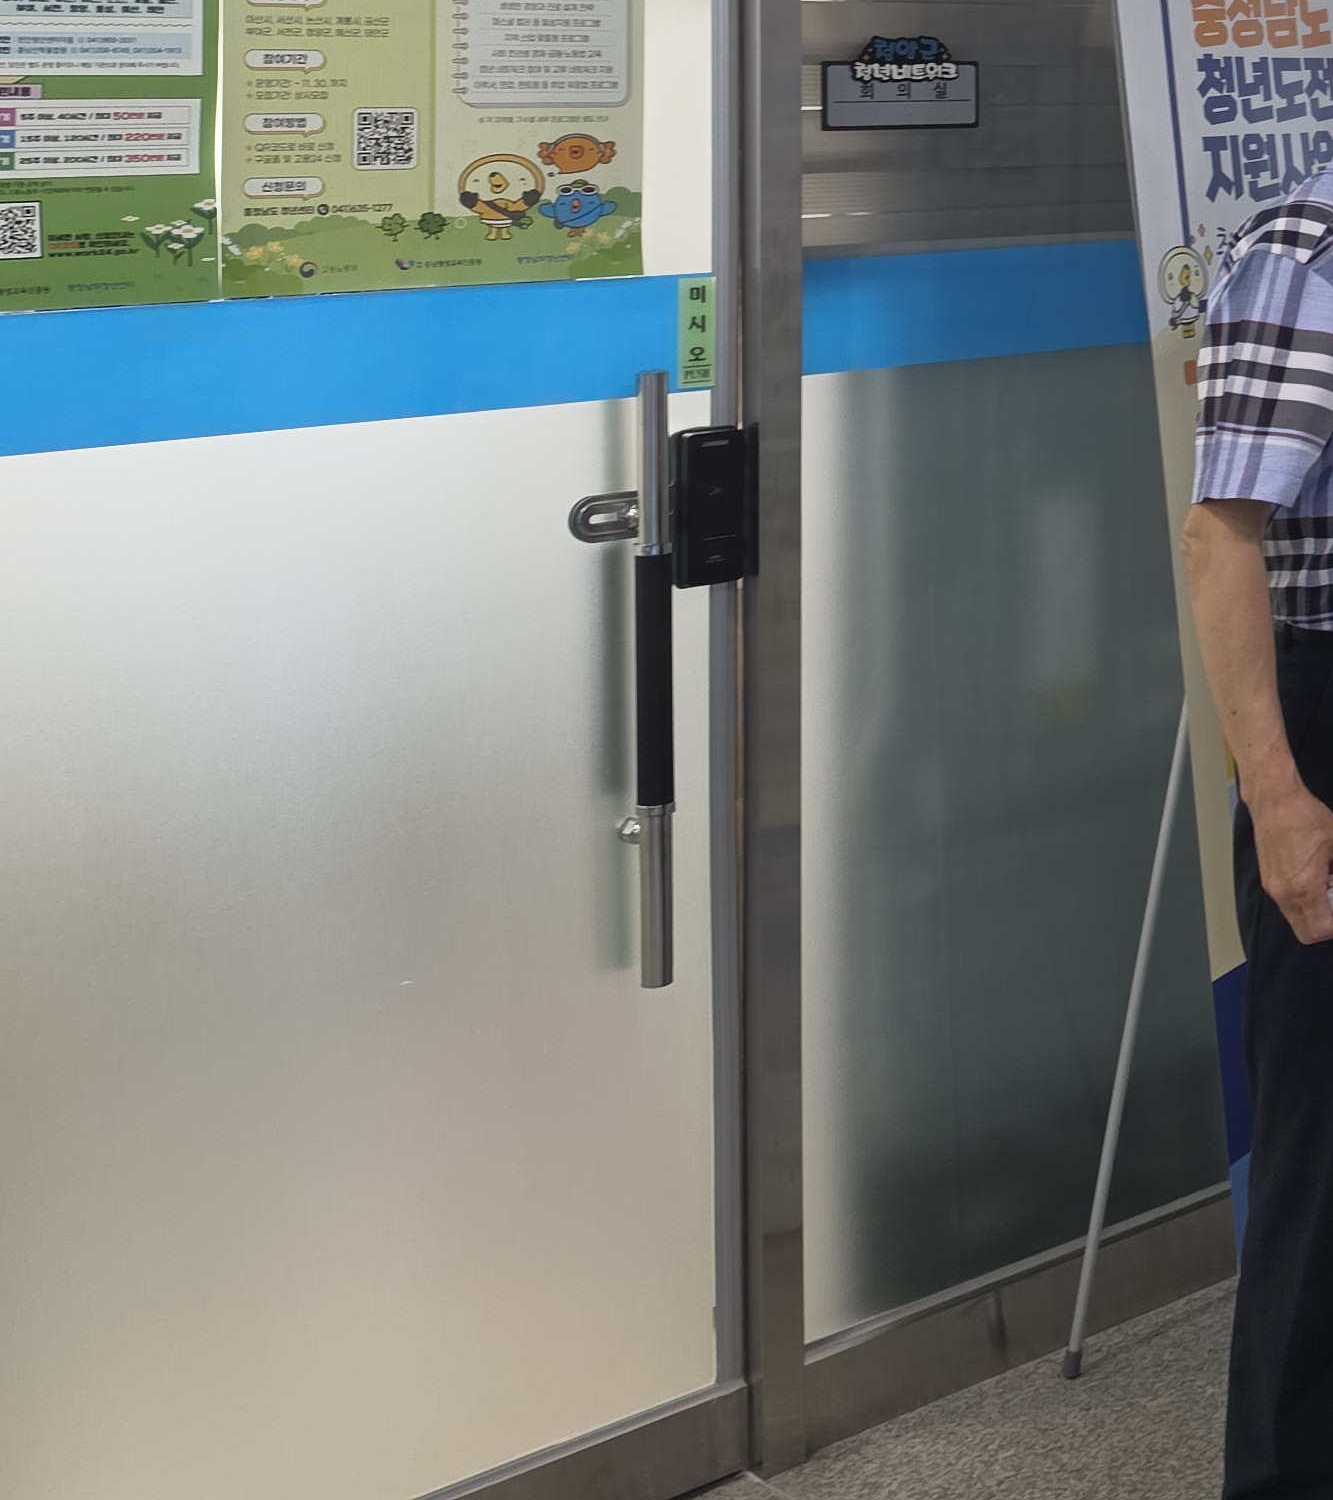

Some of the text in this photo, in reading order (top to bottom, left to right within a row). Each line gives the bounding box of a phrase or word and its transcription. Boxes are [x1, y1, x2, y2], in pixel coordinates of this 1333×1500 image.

[262, 53, 308, 65] 참여기간
[262, 117, 307, 129] 참여방법
[261, 181, 306, 193] 신청문의
[687, 285, 708, 362] 미시오
